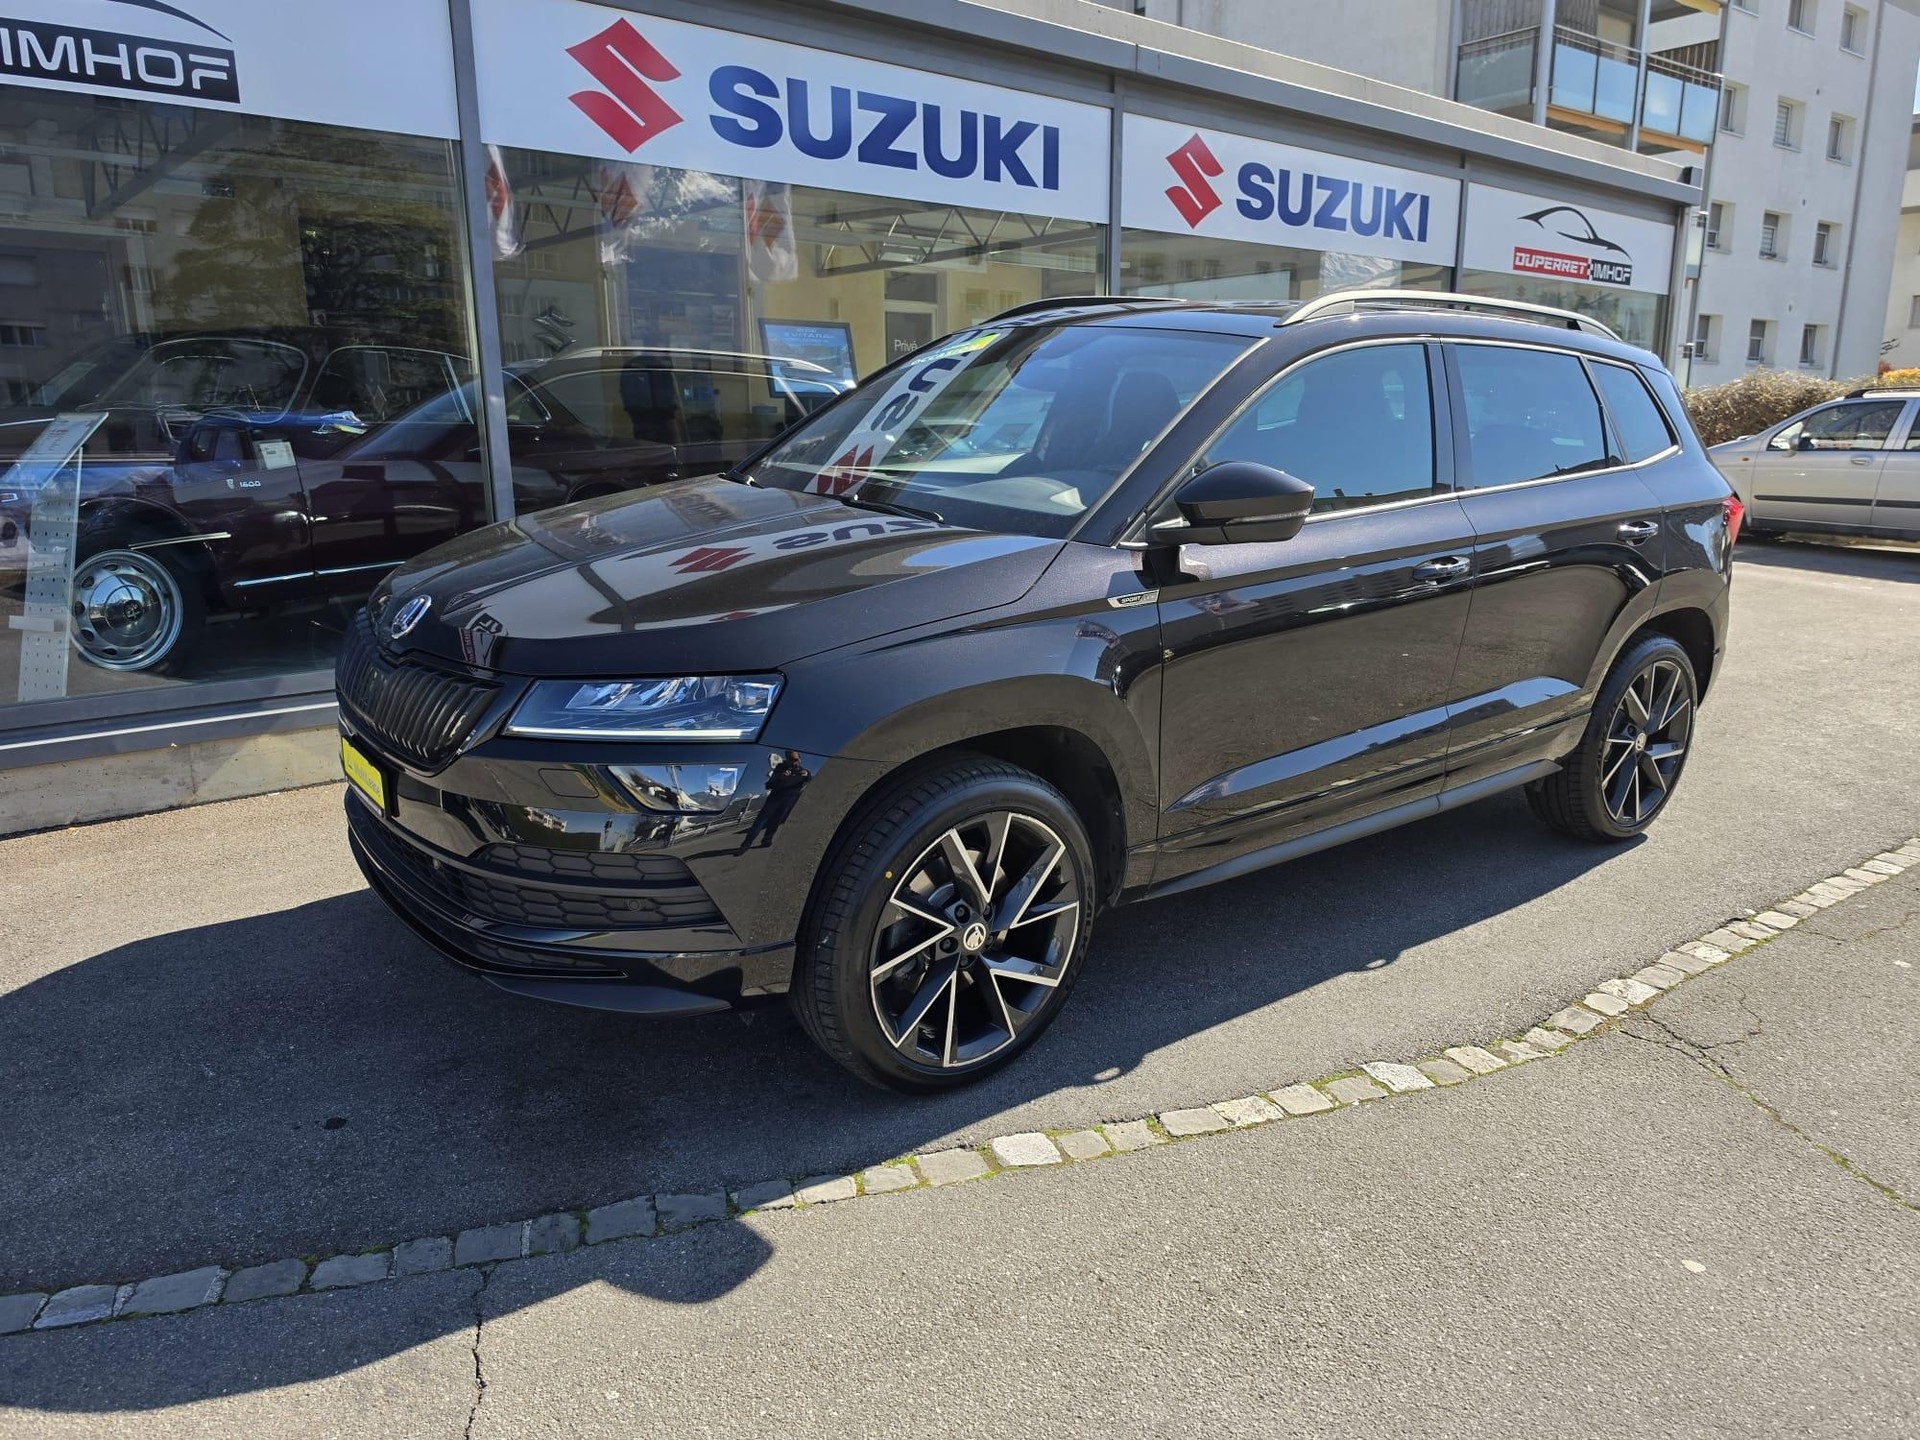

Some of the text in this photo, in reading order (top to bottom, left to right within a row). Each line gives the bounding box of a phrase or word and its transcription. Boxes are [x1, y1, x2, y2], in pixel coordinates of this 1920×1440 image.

[0, 27, 230, 90] IMHOF
[709, 65, 1059, 190] SUZUKI
[1236, 162, 1430, 243] SUZUKI
[1514, 252, 1632, 283] DUPERRET IMHOF
